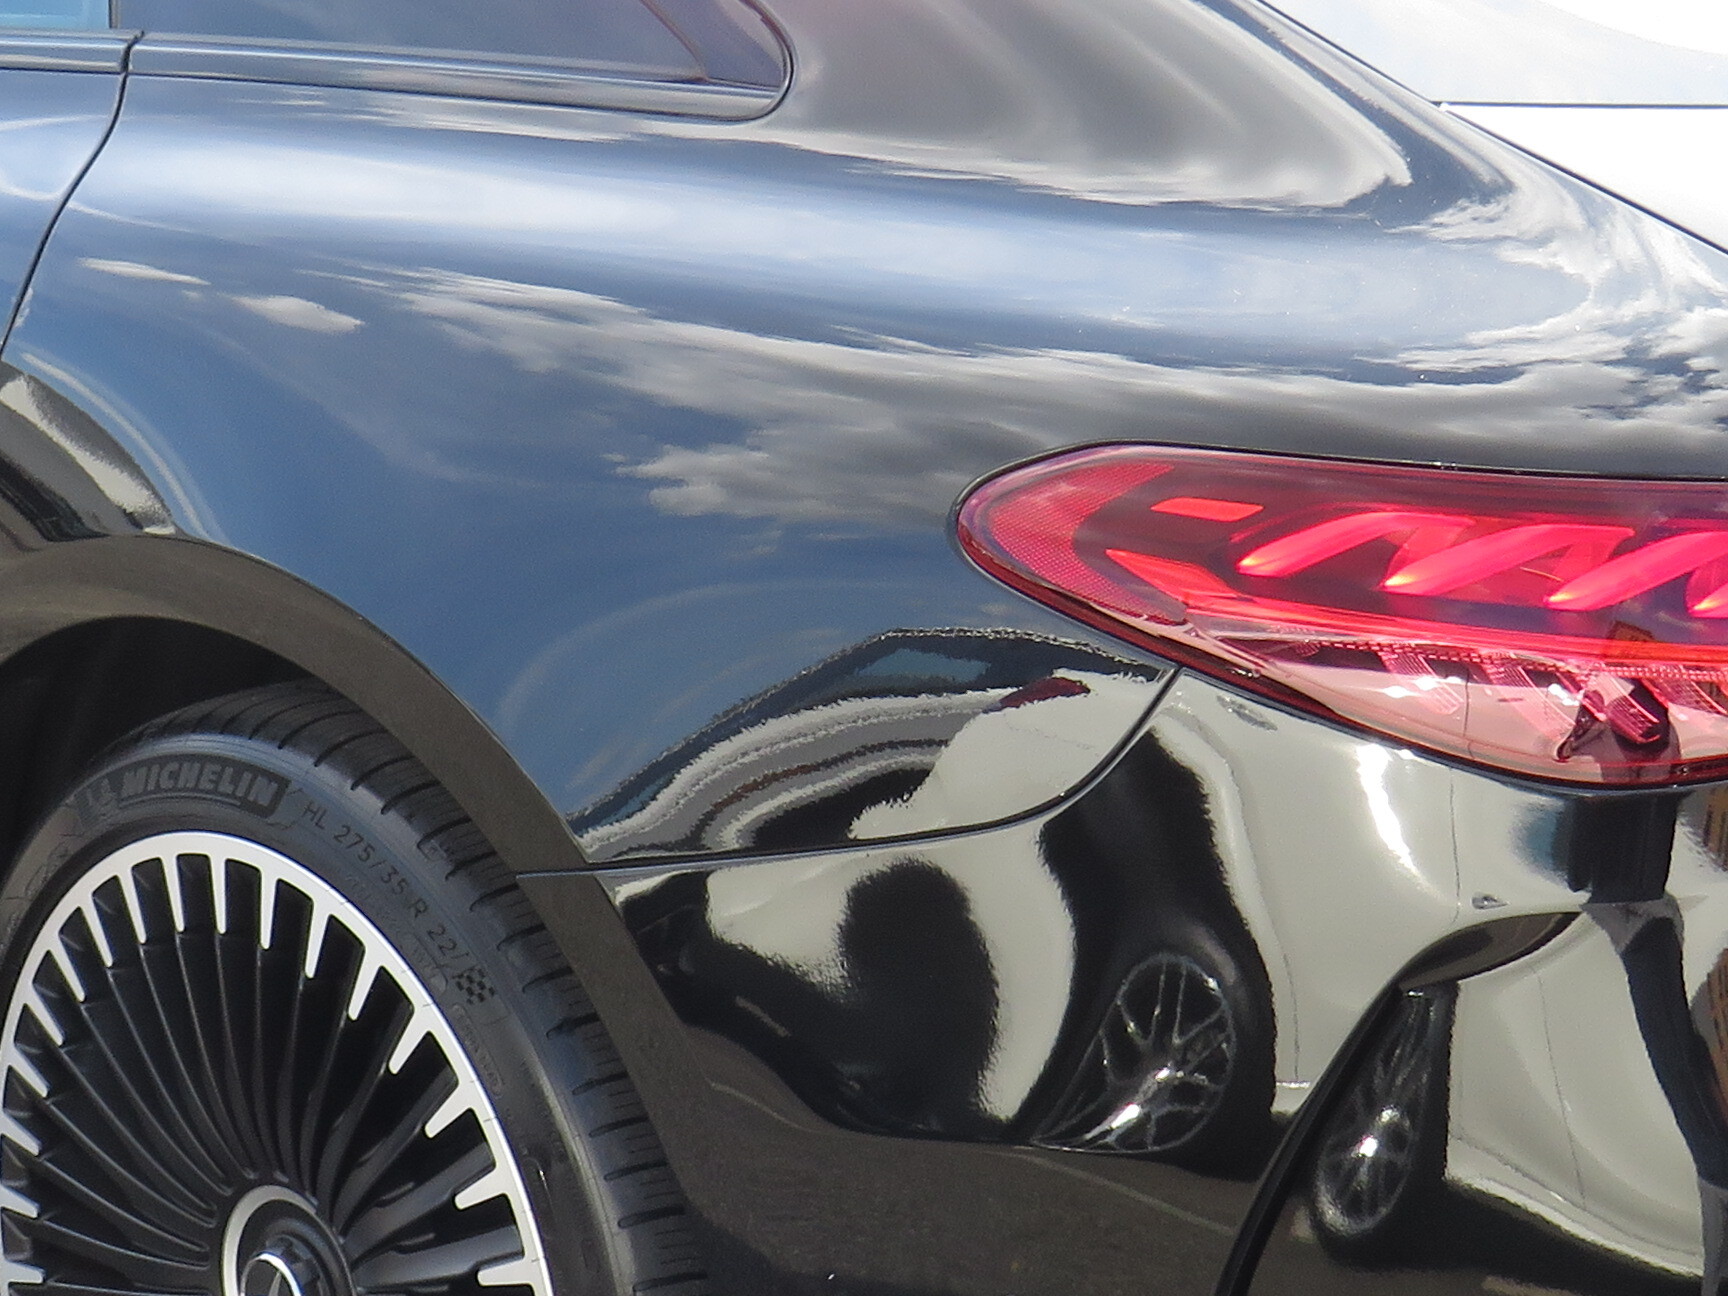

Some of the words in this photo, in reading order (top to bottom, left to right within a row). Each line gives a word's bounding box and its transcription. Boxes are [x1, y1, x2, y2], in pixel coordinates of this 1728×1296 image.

[122, 760, 279, 806] MICHELIN
[302, 801, 328, 830] HL
[332, 823, 410, 897] 275/35
[408, 898, 429, 920] R
